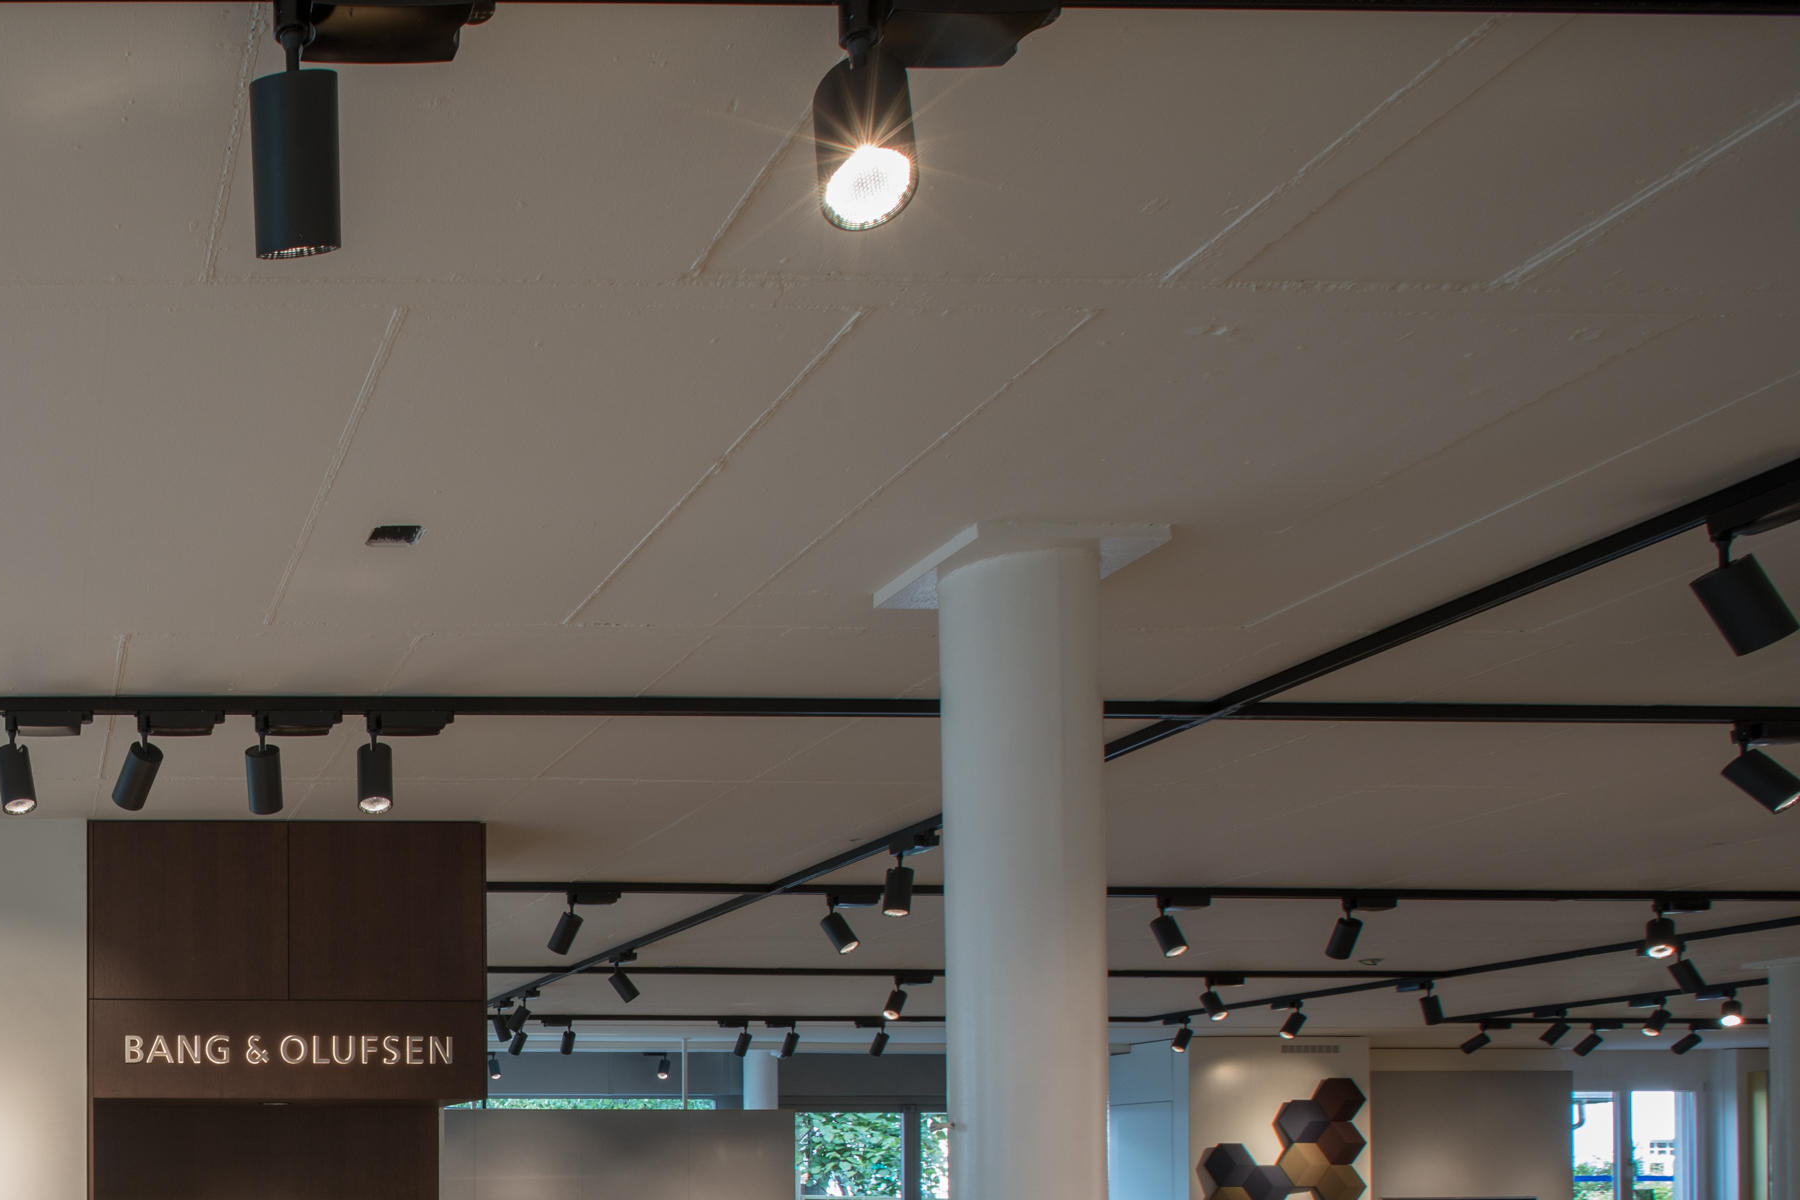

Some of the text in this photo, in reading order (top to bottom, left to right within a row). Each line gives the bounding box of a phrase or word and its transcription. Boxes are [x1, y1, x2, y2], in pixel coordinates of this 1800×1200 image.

[124, 1034, 454, 1065] BANG & OLUFSEN
